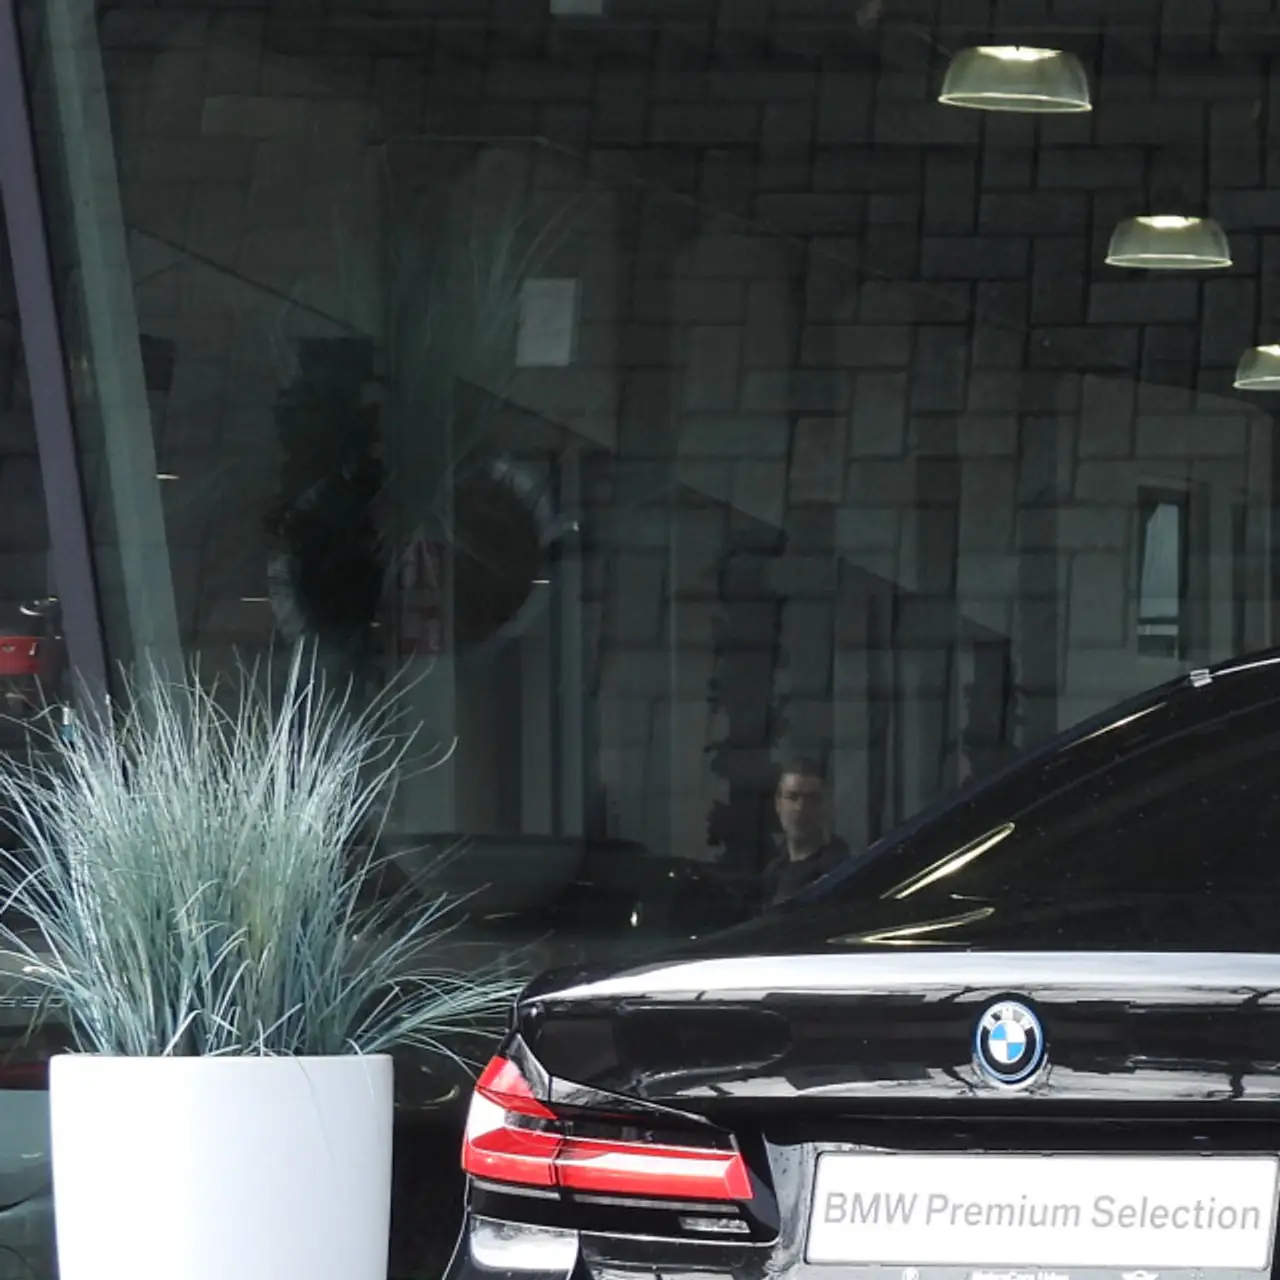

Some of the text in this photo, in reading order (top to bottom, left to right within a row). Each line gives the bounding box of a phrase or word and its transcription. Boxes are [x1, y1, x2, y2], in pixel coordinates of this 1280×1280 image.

[824, 1192, 1260, 1230] BMW Premium Selection
